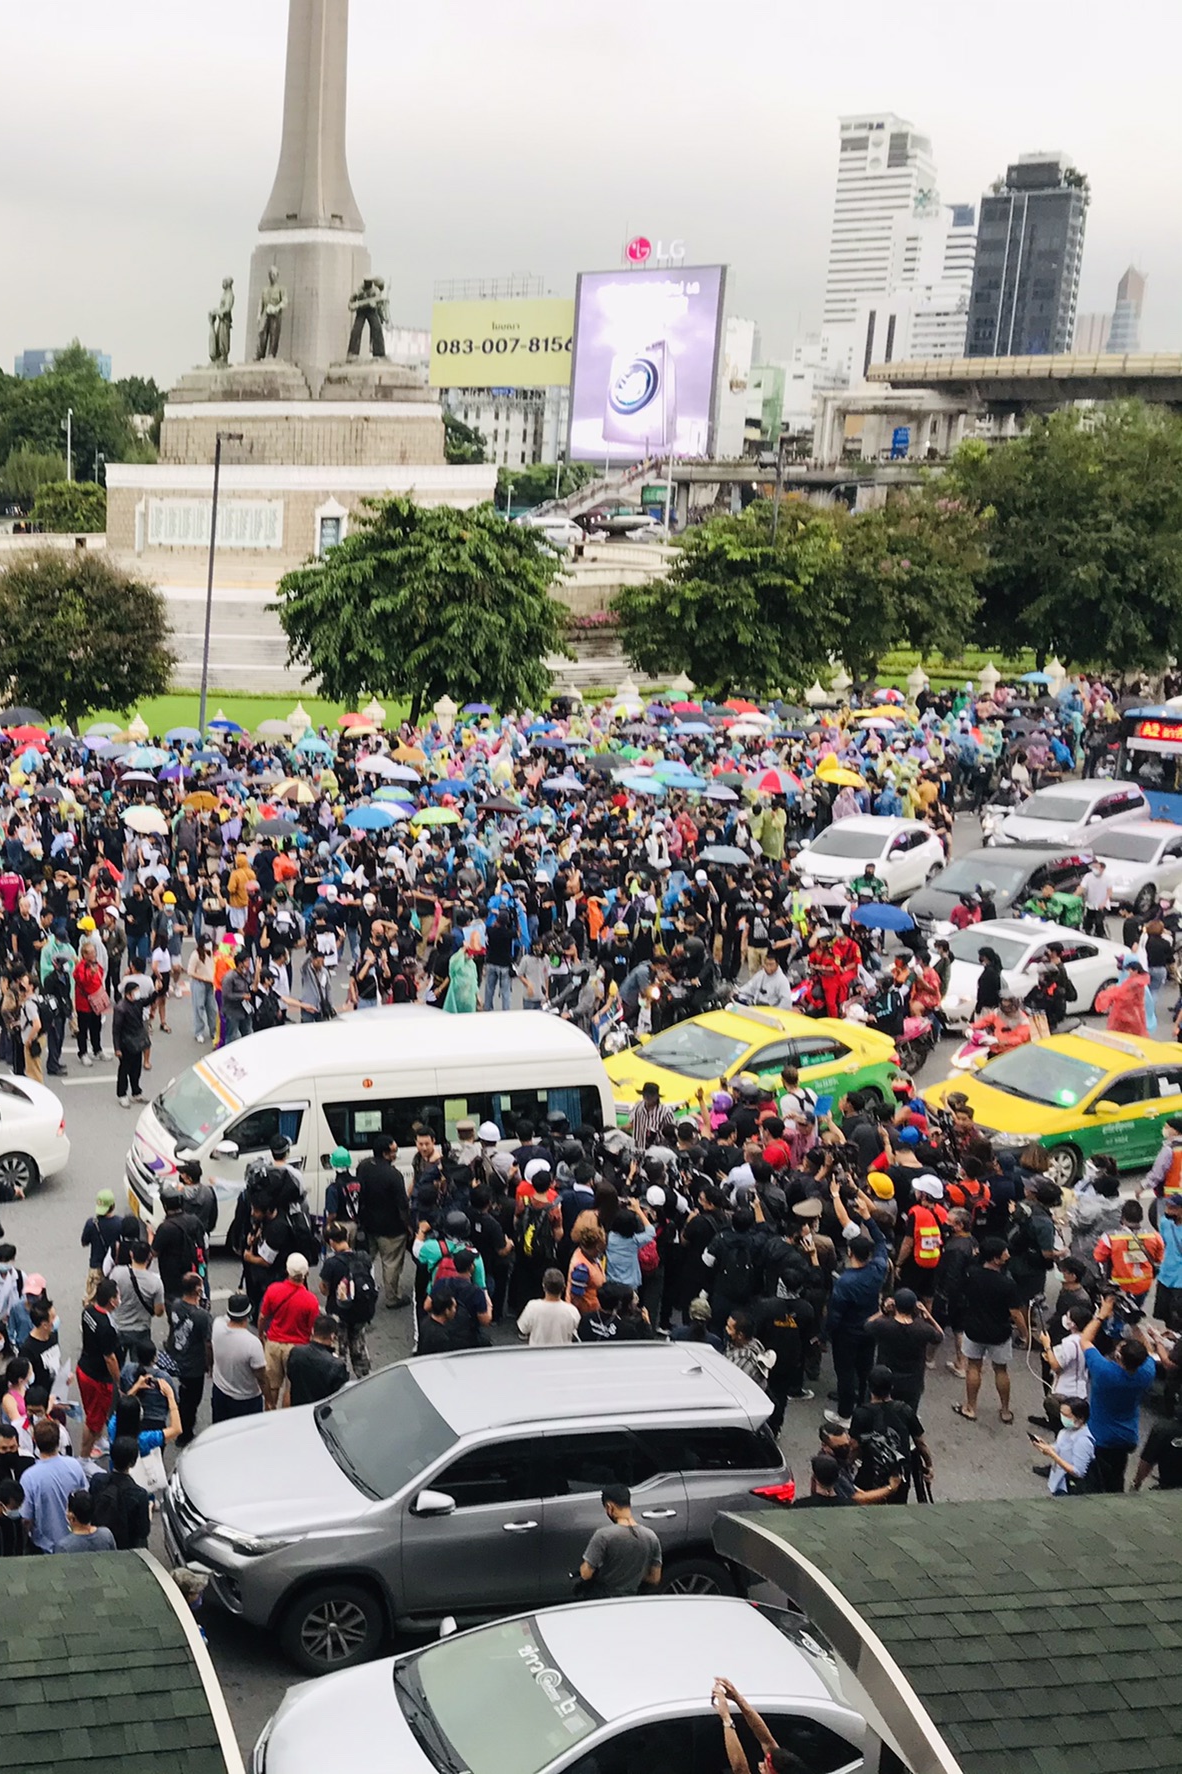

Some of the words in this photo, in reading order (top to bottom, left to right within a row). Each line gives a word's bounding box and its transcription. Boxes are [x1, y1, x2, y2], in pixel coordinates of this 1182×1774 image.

[657, 240, 685, 259] LG
[1141, 721, 1160, 738] A2
[518, 1644, 545, 1673] ข่าว
